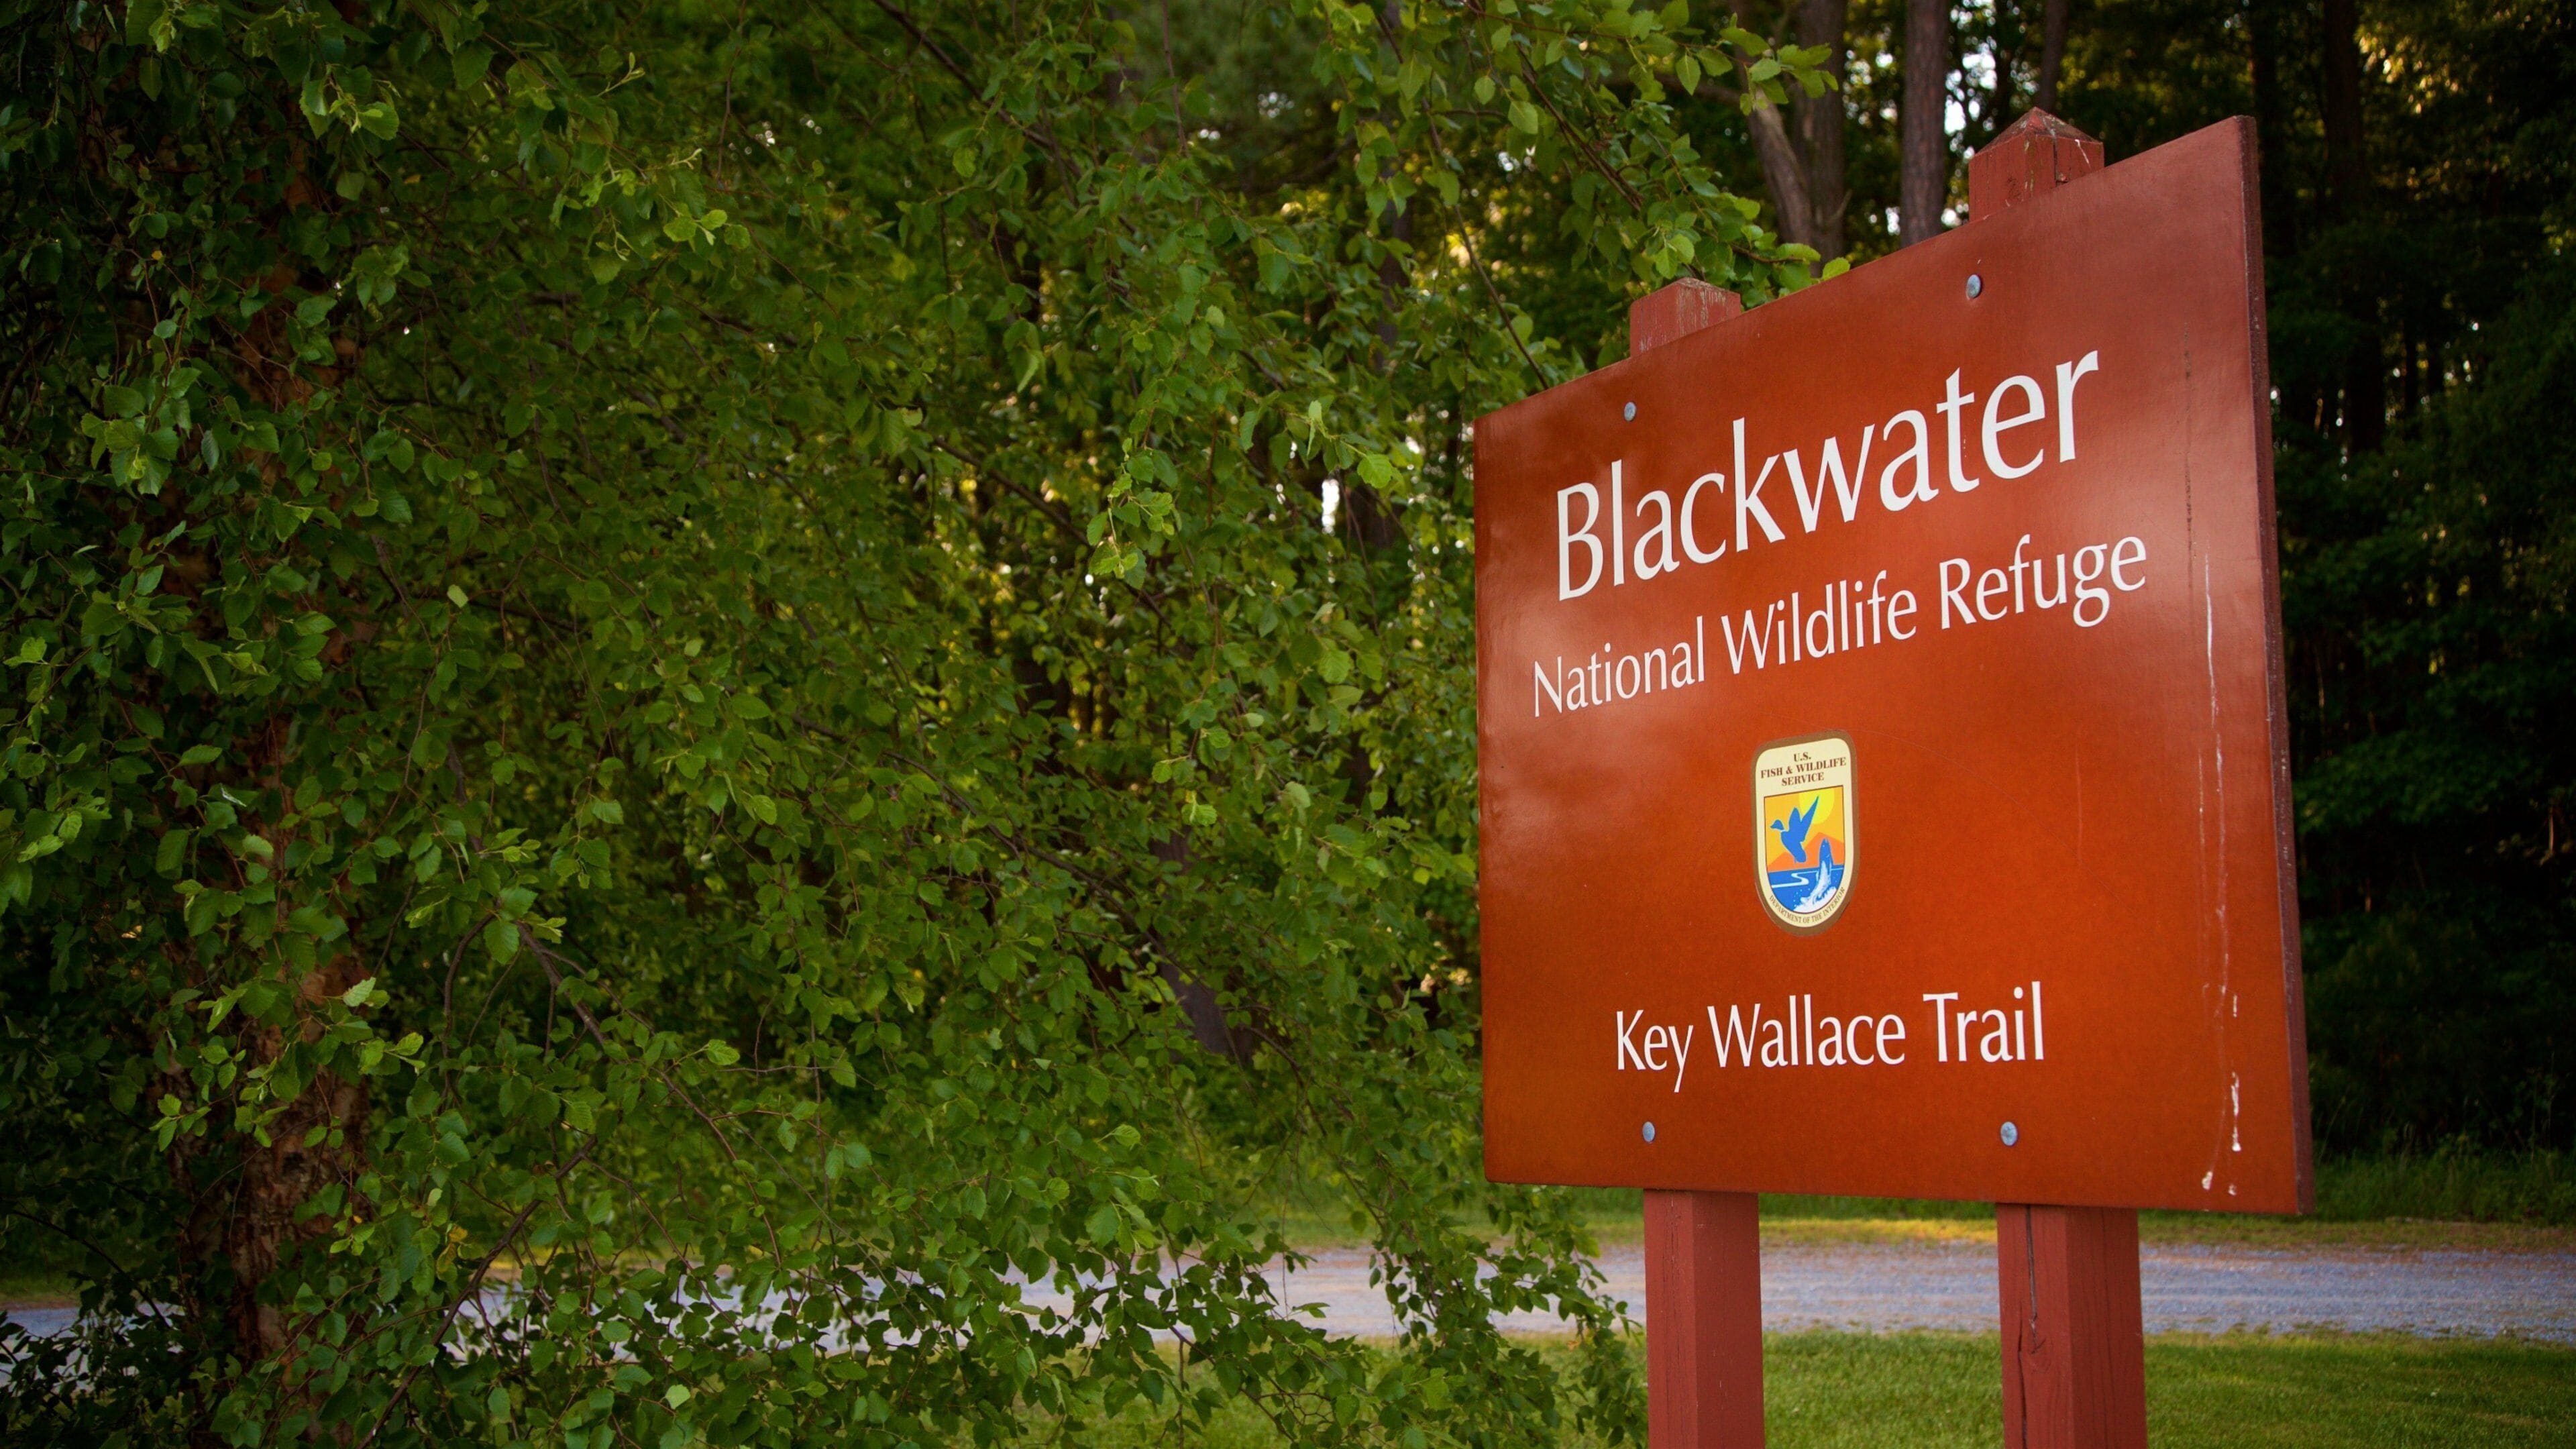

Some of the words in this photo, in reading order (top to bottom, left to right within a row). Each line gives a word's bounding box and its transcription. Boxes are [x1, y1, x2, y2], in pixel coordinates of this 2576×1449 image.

[1557, 350, 2099, 601] Blackwater
[1534, 615, 1705, 717] National
[1721, 570, 1917, 674] Wildlife
[1939, 533, 2147, 629] Refuge
[1760, 767, 1783, 779] FISH
[1786, 766, 1793, 775] &
[1796, 757, 1847, 773] WILDLIFE
[1793, 752, 1811, 762] U.S.
[1781, 772, 1825, 786] SERVICE
[1770, 895, 1802, 924] DEPARTMENT
[1812, 914, 1822, 923] THE
[1823, 887, 1845, 917] INTERIOR
[1617, 1010, 1694, 1093] Key
[1707, 994, 1906, 1068] Wallace
[1923, 981, 2044, 1063] Trail
